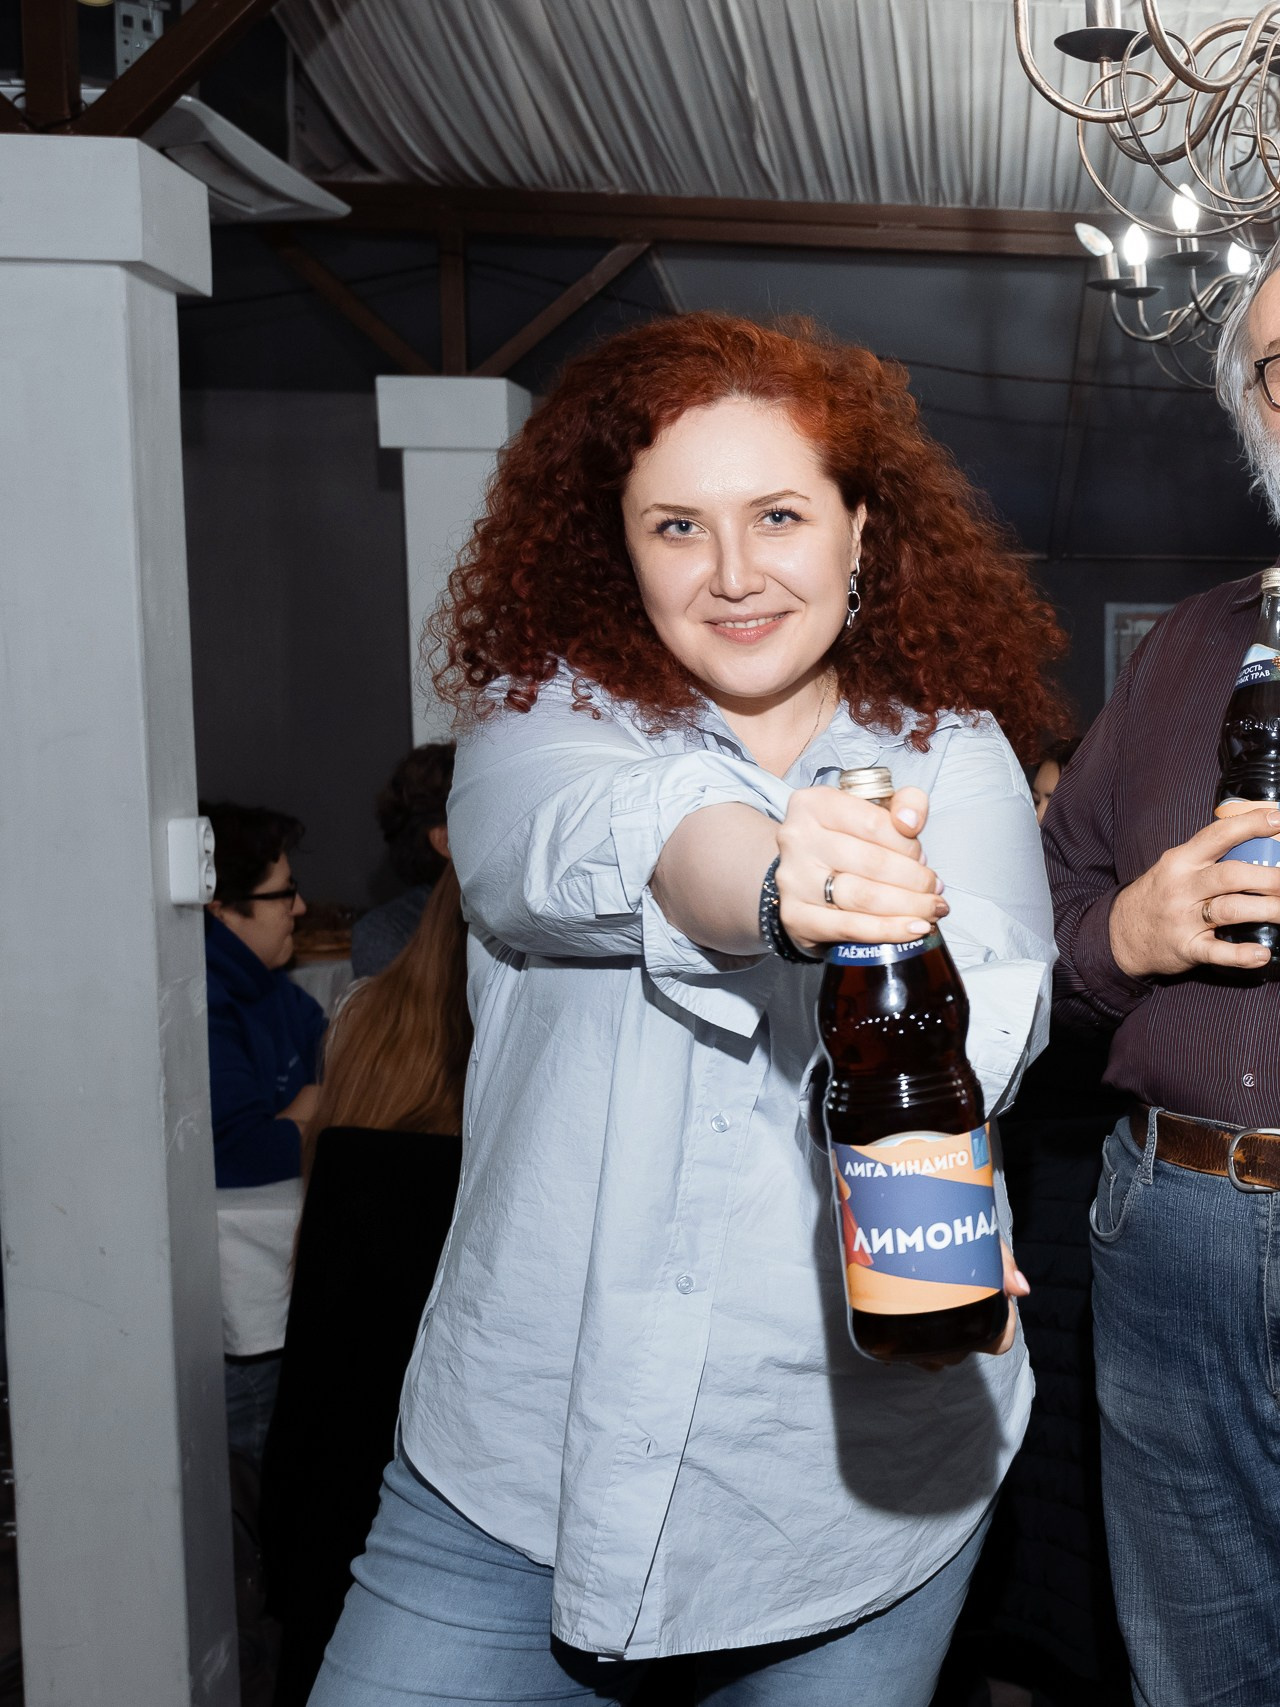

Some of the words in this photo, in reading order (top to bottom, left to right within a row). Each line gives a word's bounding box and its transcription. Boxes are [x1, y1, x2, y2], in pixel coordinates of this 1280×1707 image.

[1251, 670, 1271, 681] ТРАВ
[844, 1161, 888, 1178] ЛИГА
[891, 1151, 969, 1177] ИНДИГО
